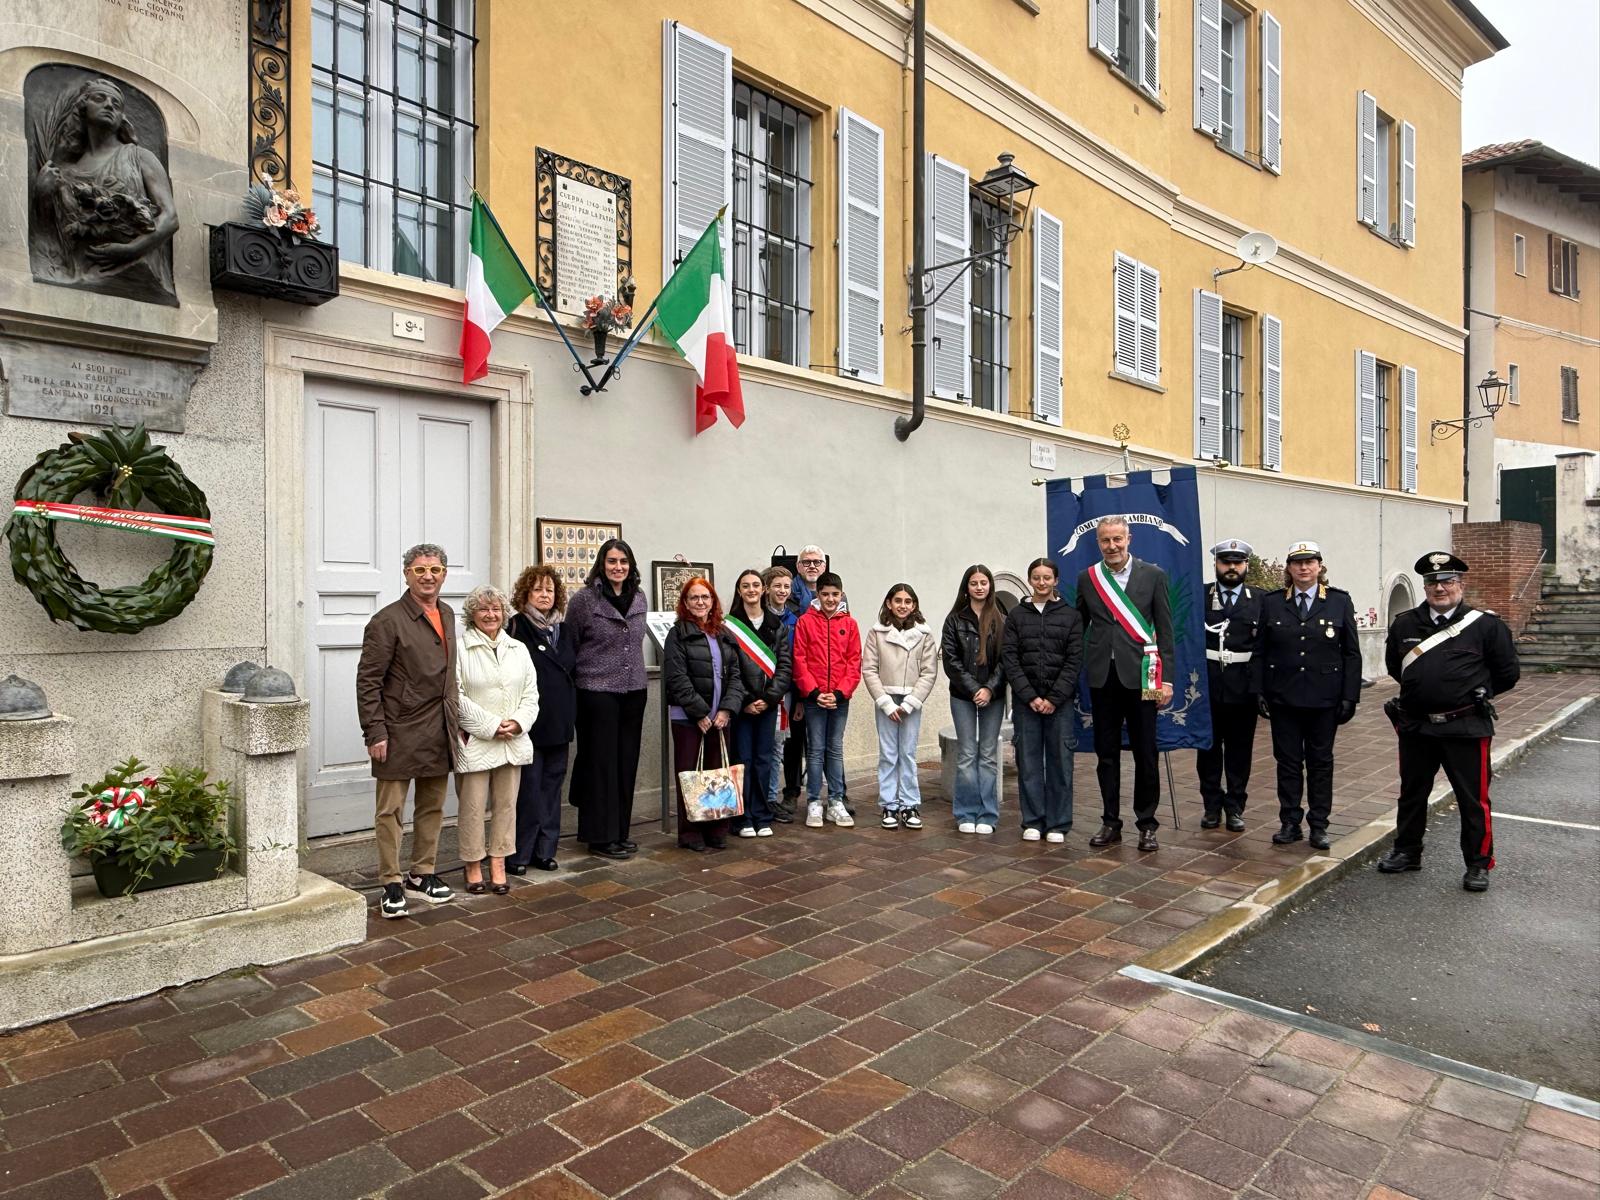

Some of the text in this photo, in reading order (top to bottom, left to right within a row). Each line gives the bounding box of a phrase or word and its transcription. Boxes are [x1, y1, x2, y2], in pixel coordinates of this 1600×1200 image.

[127, 3, 164, 22] EUGENIO
[146, 2, 184, 20] GIOVANNI
[71, 362, 132, 376] AI SUOI FIGLI
[22, 374, 40, 384] PER
[44, 377, 55, 386] LA
[116, 386, 144, 397] DELLA
[146, 390, 174, 400] PATRIA
[85, 374, 118, 384] CADUTI
[42, 388, 158, 408] CAMBIANO RICONOSCENTE
[90, 404, 114, 416] 1921
